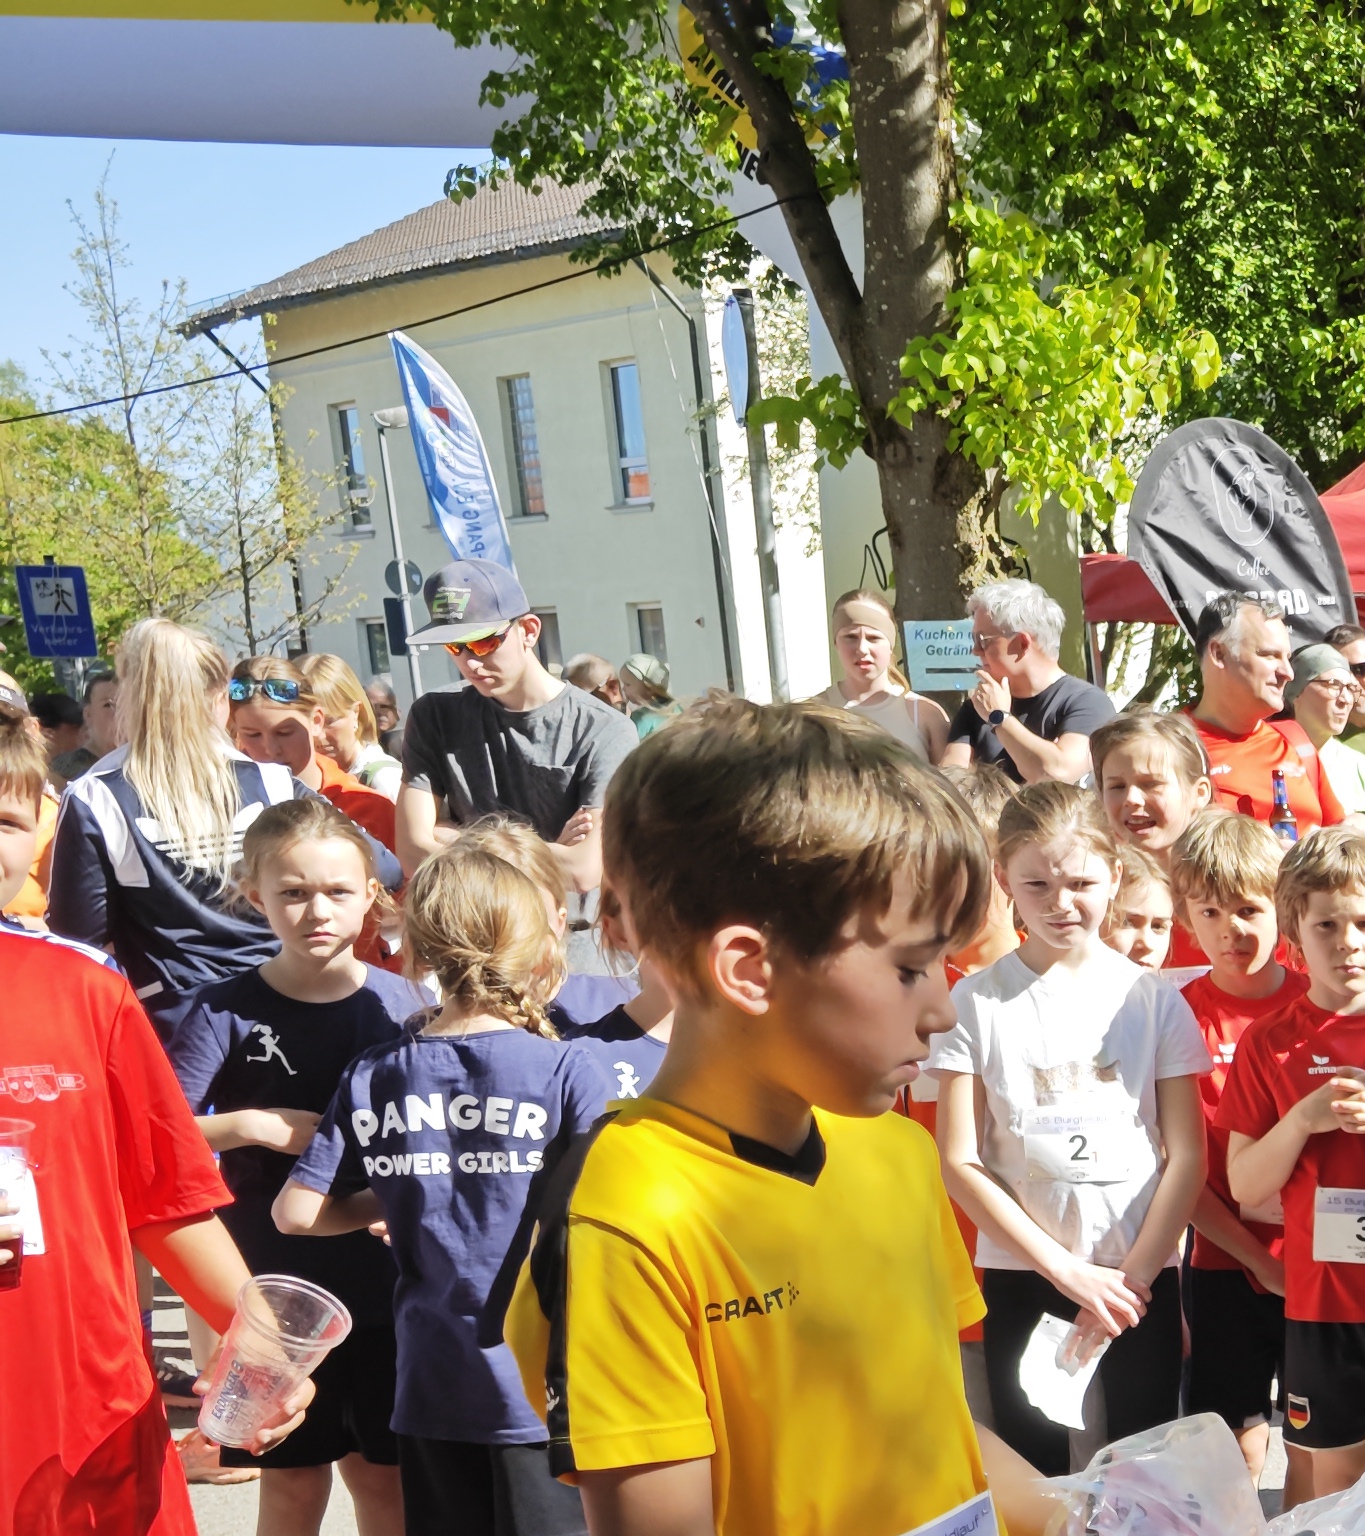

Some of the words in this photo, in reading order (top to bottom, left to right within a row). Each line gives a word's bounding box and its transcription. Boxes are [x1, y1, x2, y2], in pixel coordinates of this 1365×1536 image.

[1236, 556, 1271, 581] Coffee
[914, 628, 964, 640] Kuchen
[1308, 1066, 1337, 1075] erima
[351, 1092, 548, 1147] PANGER
[1068, 1134, 1090, 1161] 2
[362, 1151, 451, 1177] POWER
[458, 1150, 545, 1174] GIRLS
[705, 1287, 784, 1323] CRAFT
